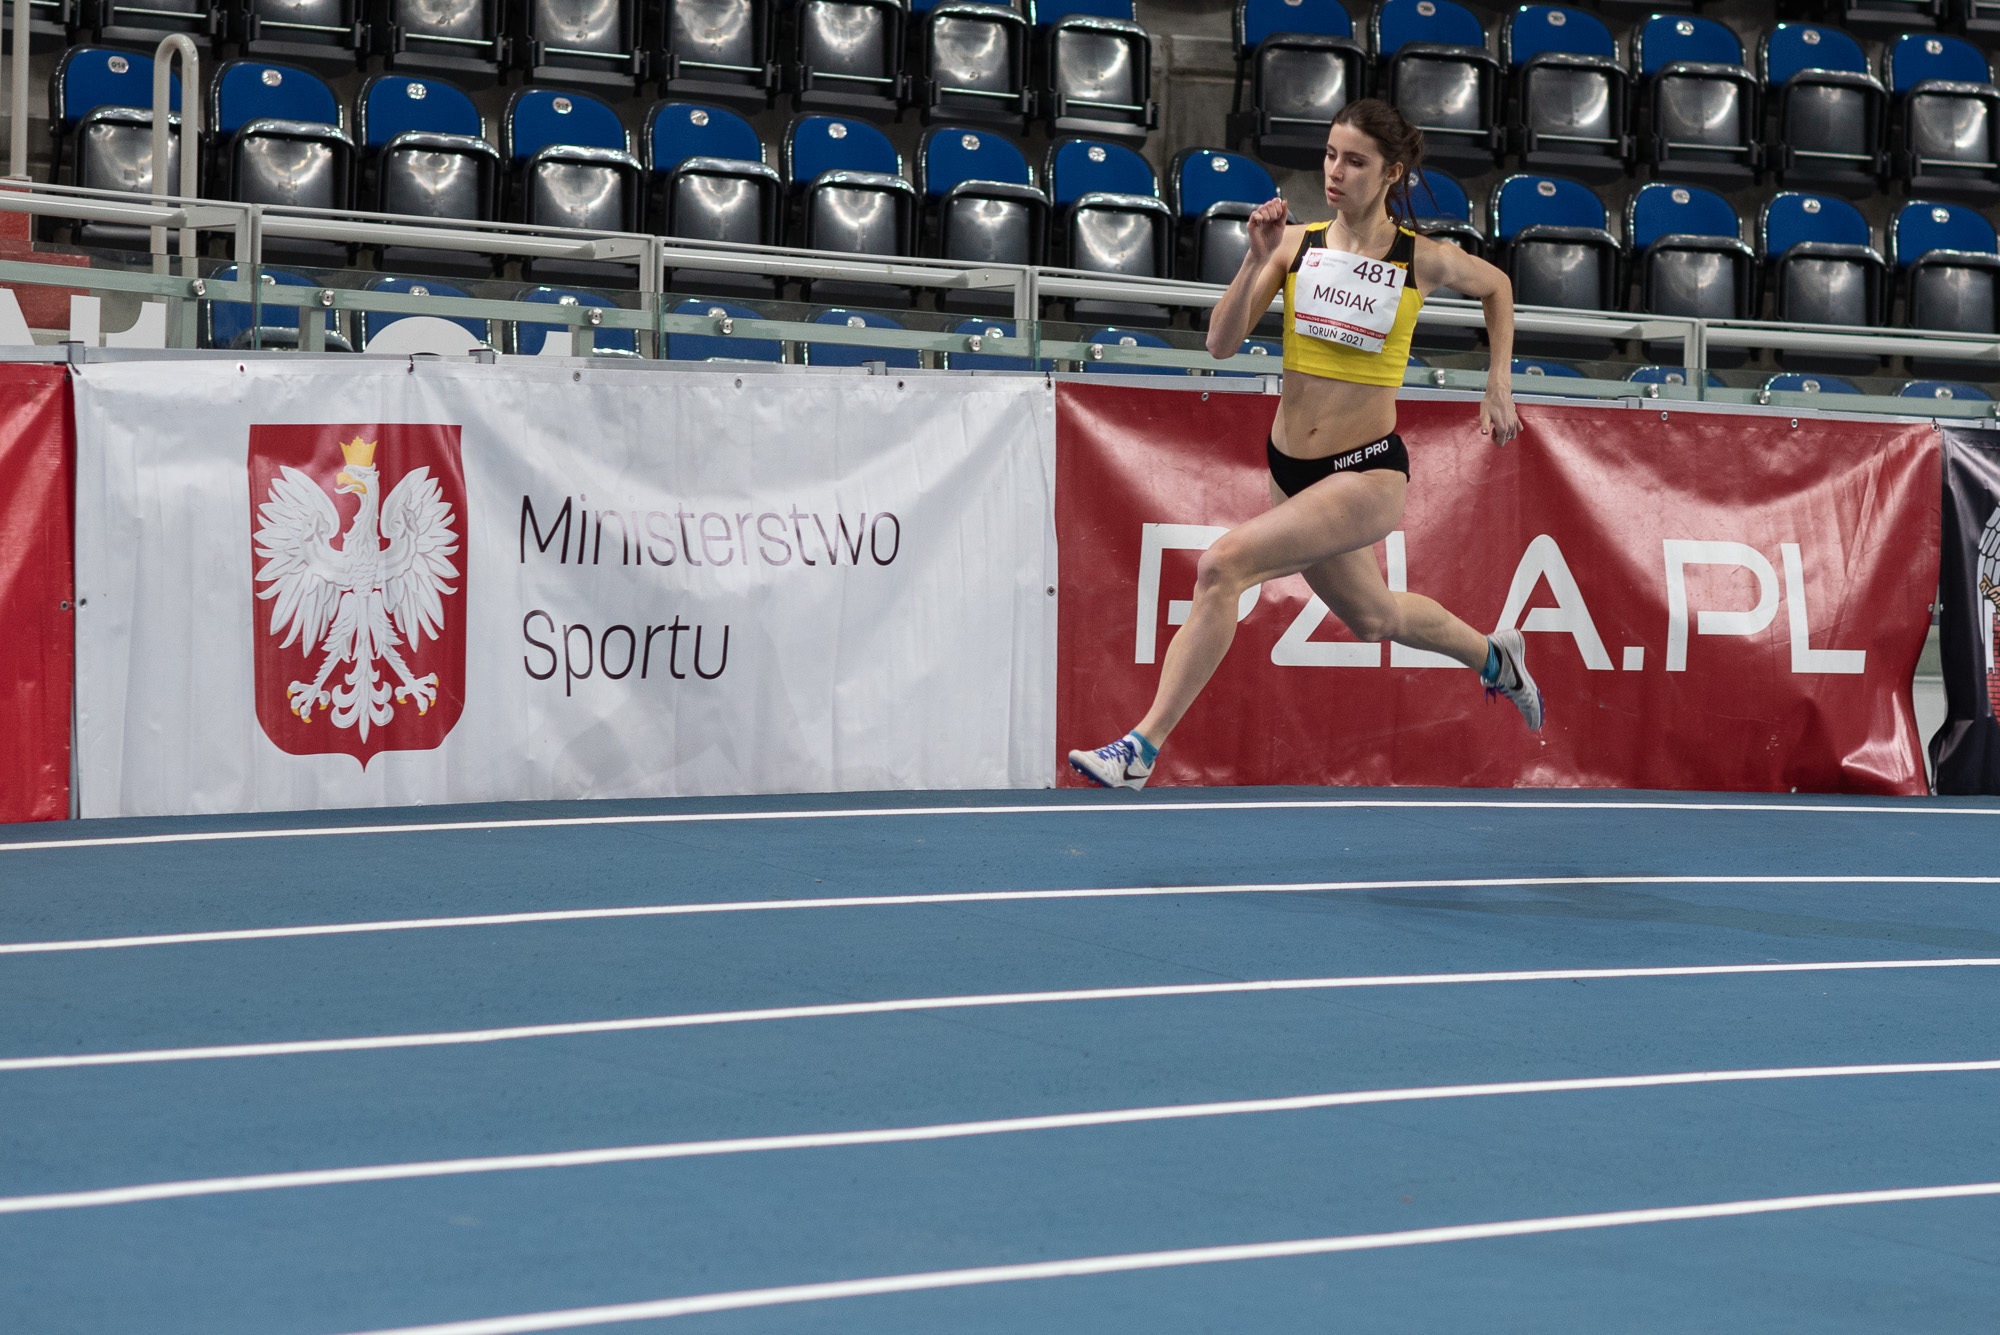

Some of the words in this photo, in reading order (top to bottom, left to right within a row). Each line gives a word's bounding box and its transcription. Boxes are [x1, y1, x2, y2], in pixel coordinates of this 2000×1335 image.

[1353, 260, 1396, 288] 481
[1313, 284, 1377, 314] MISIAK
[1308, 324, 1338, 339] TORUŃ
[1340, 332, 1364, 347] 2021
[1334, 450, 1363, 471] NIKE
[1365, 439, 1389, 459] PRO
[519, 493, 901, 567] Ministerstwo
[522, 609, 730, 697] Sportu
